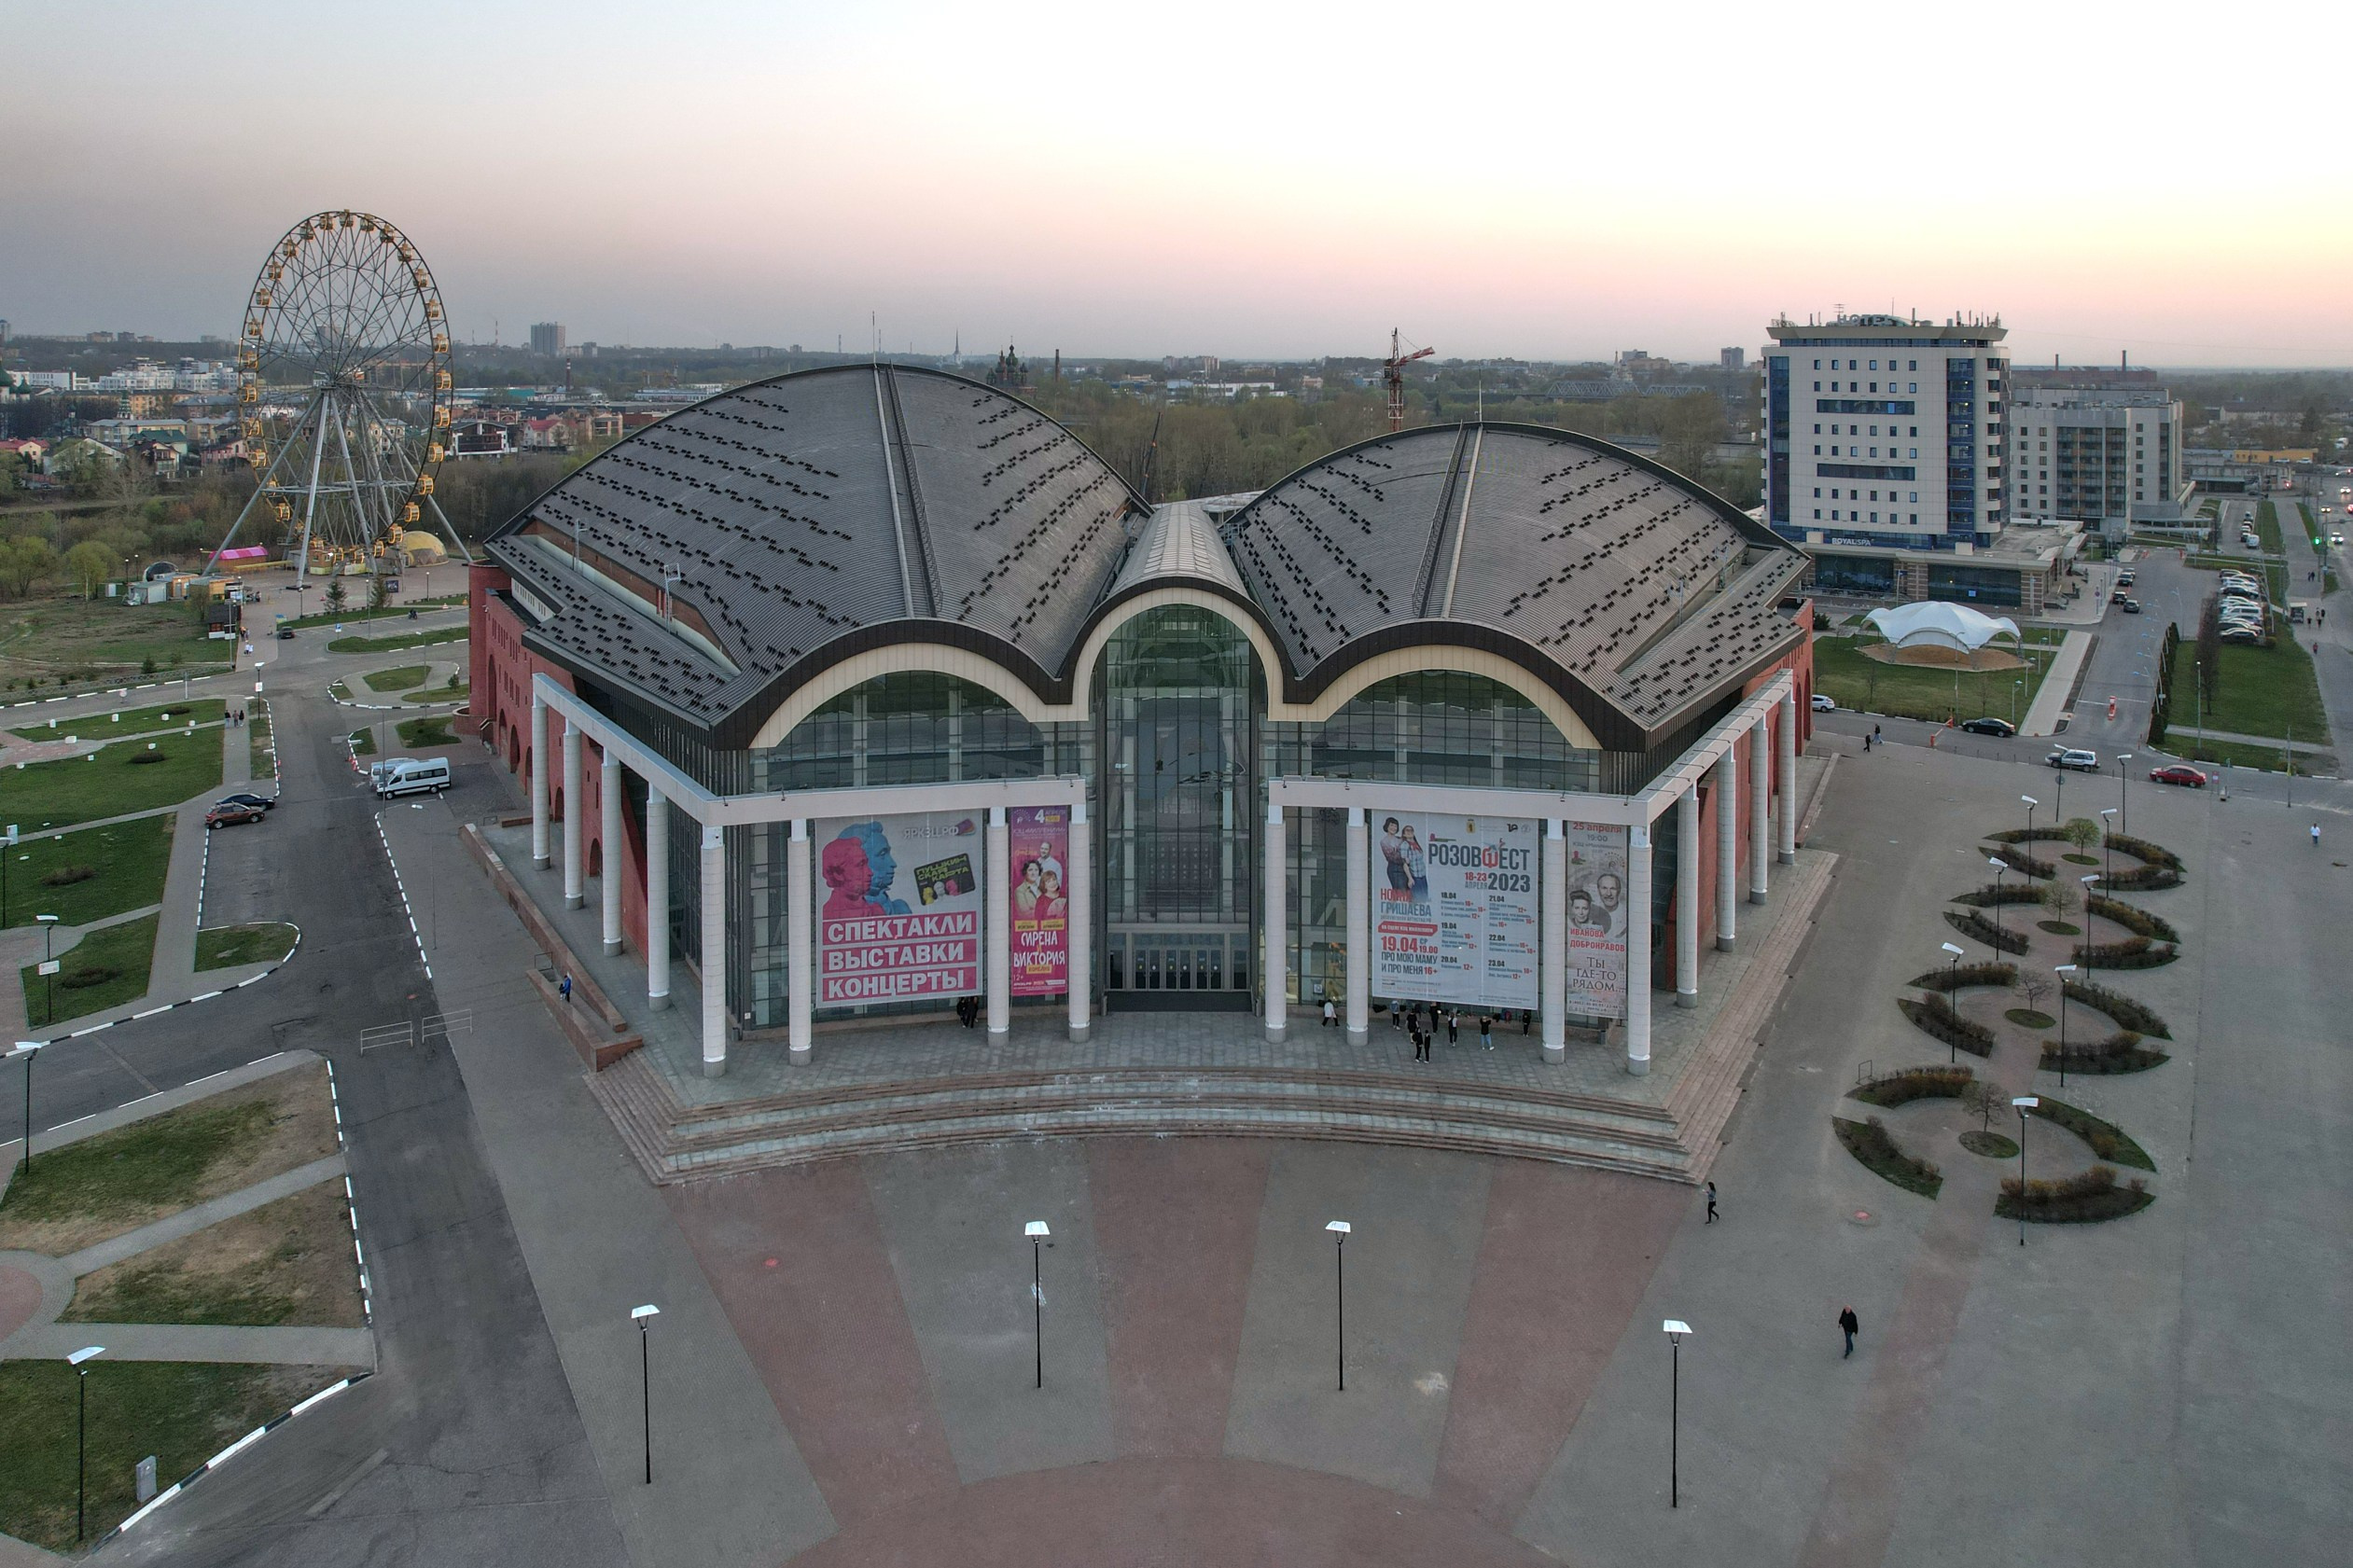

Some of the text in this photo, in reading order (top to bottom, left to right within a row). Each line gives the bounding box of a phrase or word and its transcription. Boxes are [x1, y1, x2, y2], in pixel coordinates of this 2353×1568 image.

[1837, 314, 1895, 326] HOTEL
[1035, 809, 1045, 824] 4
[1573, 822, 1622, 833] 25 апреля
[931, 866, 969, 882] КАРТА
[1465, 871, 1531, 893] 18-23 2023
[1465, 881, 1488, 890] АПРЕЛЯ
[1381, 901, 1432, 917] ГРИШАЕВА
[828, 914, 972, 942] СПЕКТАКЛИ
[1570, 928, 1605, 938] ИВАНОВА
[1021, 930, 1058, 947] СИРЕНА
[1381, 936, 1418, 952] 19.04
[1569, 939, 1625, 951] ДОБРОНРАВОВ
[828, 941, 964, 971] ВЫСТАВКИ
[1419, 945, 1439, 954] 19.00
[1013, 950, 1065, 967] ВИКТОРИЯ
[1381, 951, 1438, 964] ПРО МОЮ МАМУ
[1441, 955, 1457, 964] 20.04
[1488, 959, 1505, 967] 23.04
[1381, 963, 1386, 973] И
[1387, 964, 1402, 974] ПРО
[1402, 964, 1424, 975] МЕНЯ
[1424, 966, 1438, 976] 16+
[1576, 968, 1617, 981] ГДЕ-ТО
[1013, 973, 1023, 981] 12+
[828, 969, 964, 999] КОНЦЕРТЫ
